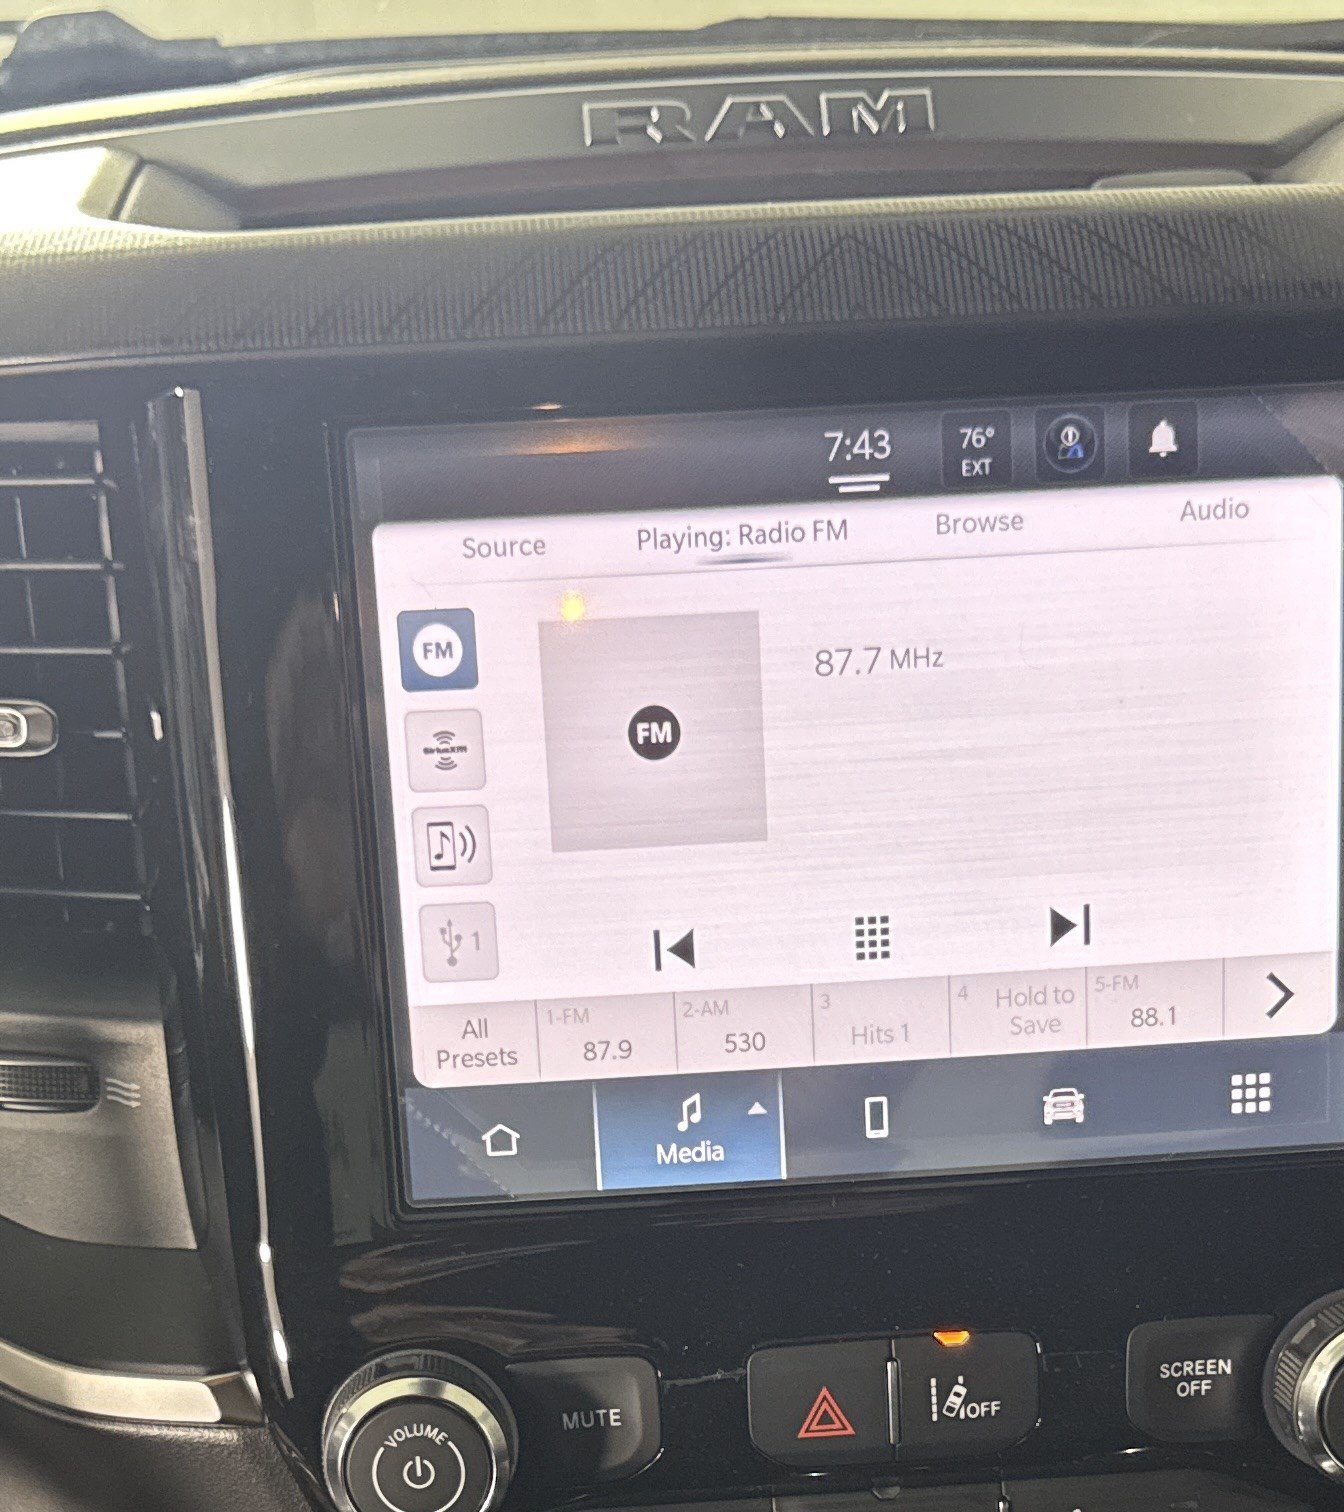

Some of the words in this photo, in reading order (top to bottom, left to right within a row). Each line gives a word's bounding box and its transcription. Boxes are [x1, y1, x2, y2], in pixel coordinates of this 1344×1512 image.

[582, 86, 935, 147] RAM
[824, 428, 892, 462] 7:43
[960, 427, 995, 451] 76°
[961, 458, 992, 478] EXT
[1180, 498, 1249, 522] Audio
[936, 512, 1024, 536] Browse
[637, 525, 731, 553] Playing:
[739, 521, 806, 546] Radio
[813, 519, 848, 542] FM
[462, 537, 546, 560] Source
[422, 641, 453, 660] FM
[814, 648, 881, 677] 87.7
[890, 648, 943, 669] MHz
[636, 721, 673, 745] FM
[471, 930, 481, 952] 1
[957, 985, 969, 1001] 4
[1094, 975, 1139, 992] 5-FM
[820, 993, 831, 1009] 3
[996, 986, 1048, 1008] Hold
[1054, 987, 1075, 1005] to
[546, 1008, 590, 1026] 1-FM
[683, 999, 729, 1018] 2-AM
[1131, 1005, 1177, 1028] 88.1
[461, 1018, 488, 1040] All
[851, 1024, 895, 1046] Hits
[901, 1024, 910, 1043] 1
[1010, 1015, 1062, 1036] Save
[583, 1040, 633, 1062] 87.9
[724, 1031, 766, 1054] 530
[437, 1047, 518, 1070] Presets
[656, 1140, 724, 1165] Media
[1159, 1358, 1232, 1379] SCREEN
[1176, 1379, 1212, 1398] OFF
[562, 1408, 622, 1431] MUTE
[966, 1401, 1001, 1420] OFF
[383, 1423, 448, 1449] VOLUME
